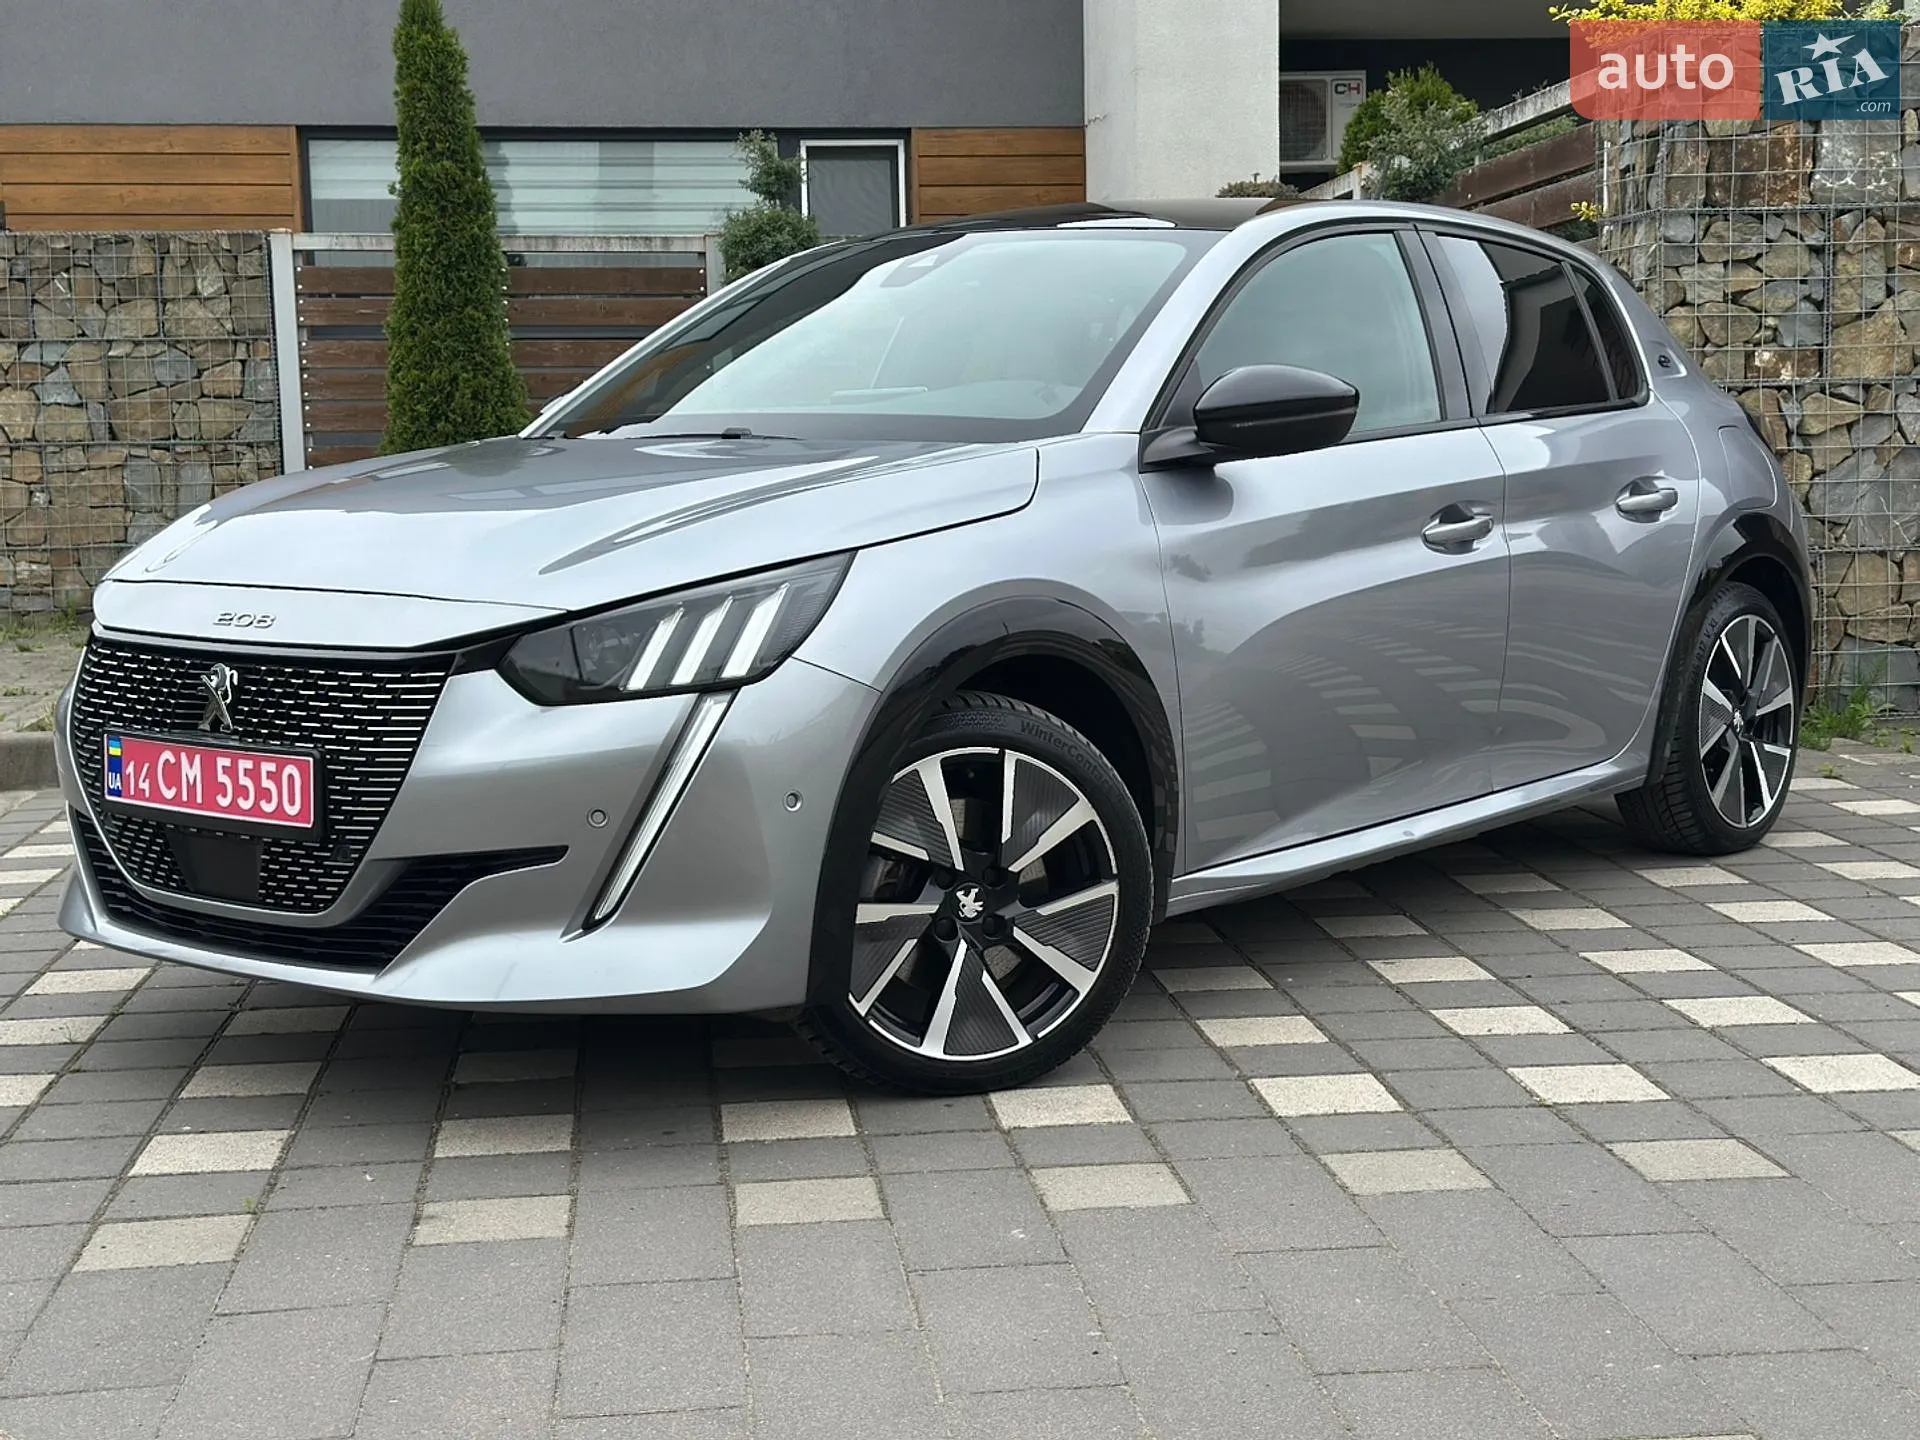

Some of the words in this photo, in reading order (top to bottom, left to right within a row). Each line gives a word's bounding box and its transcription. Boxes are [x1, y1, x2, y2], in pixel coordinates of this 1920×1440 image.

[1334, 82, 1360, 95] CH
[212, 611, 276, 630] 208
[108, 772, 122, 790] UA
[157, 750, 203, 804] CM
[215, 756, 302, 816] 5550
